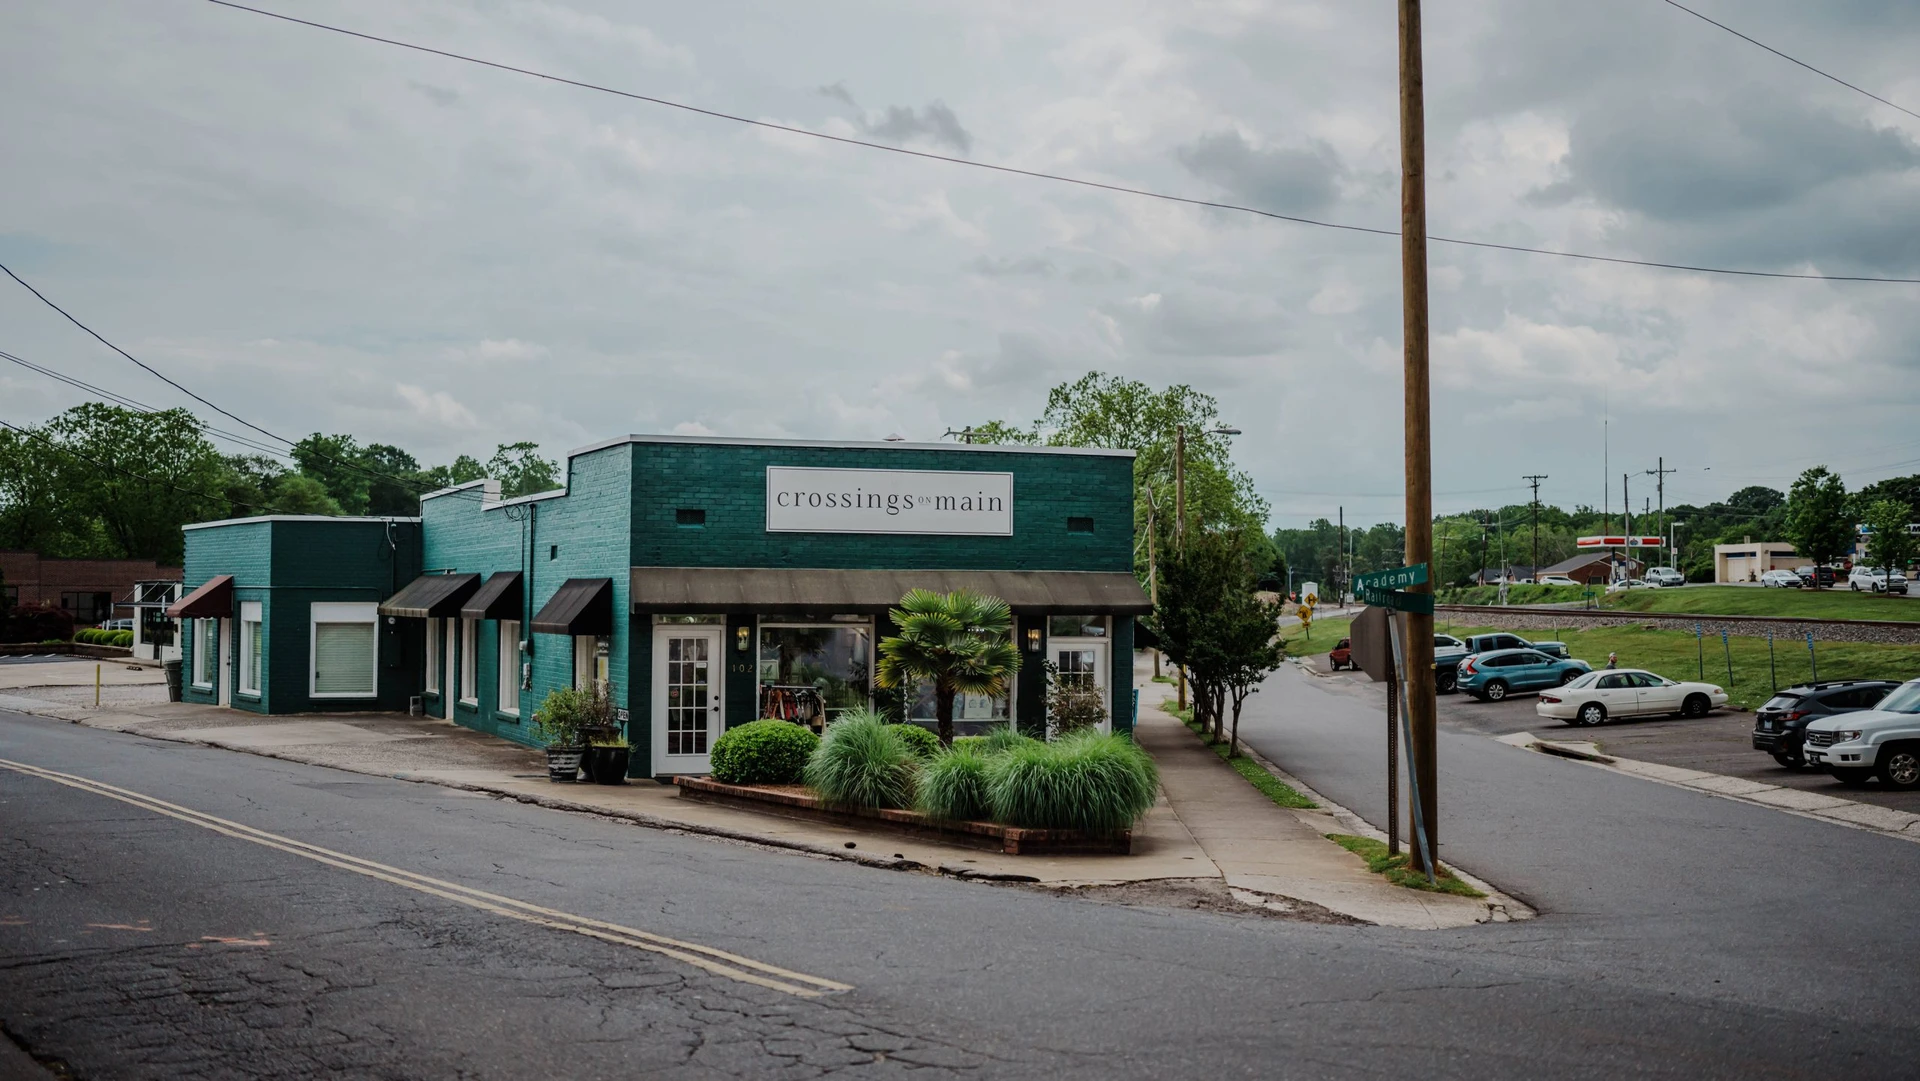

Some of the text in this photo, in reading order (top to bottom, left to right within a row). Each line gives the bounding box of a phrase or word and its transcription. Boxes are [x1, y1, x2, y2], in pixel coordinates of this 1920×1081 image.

[777, 488, 1003, 516] crossings ON main
[1356, 571, 1415, 591] Academy
[731, 664, 753, 673] 102
[618, 710, 628, 719] OPEN
